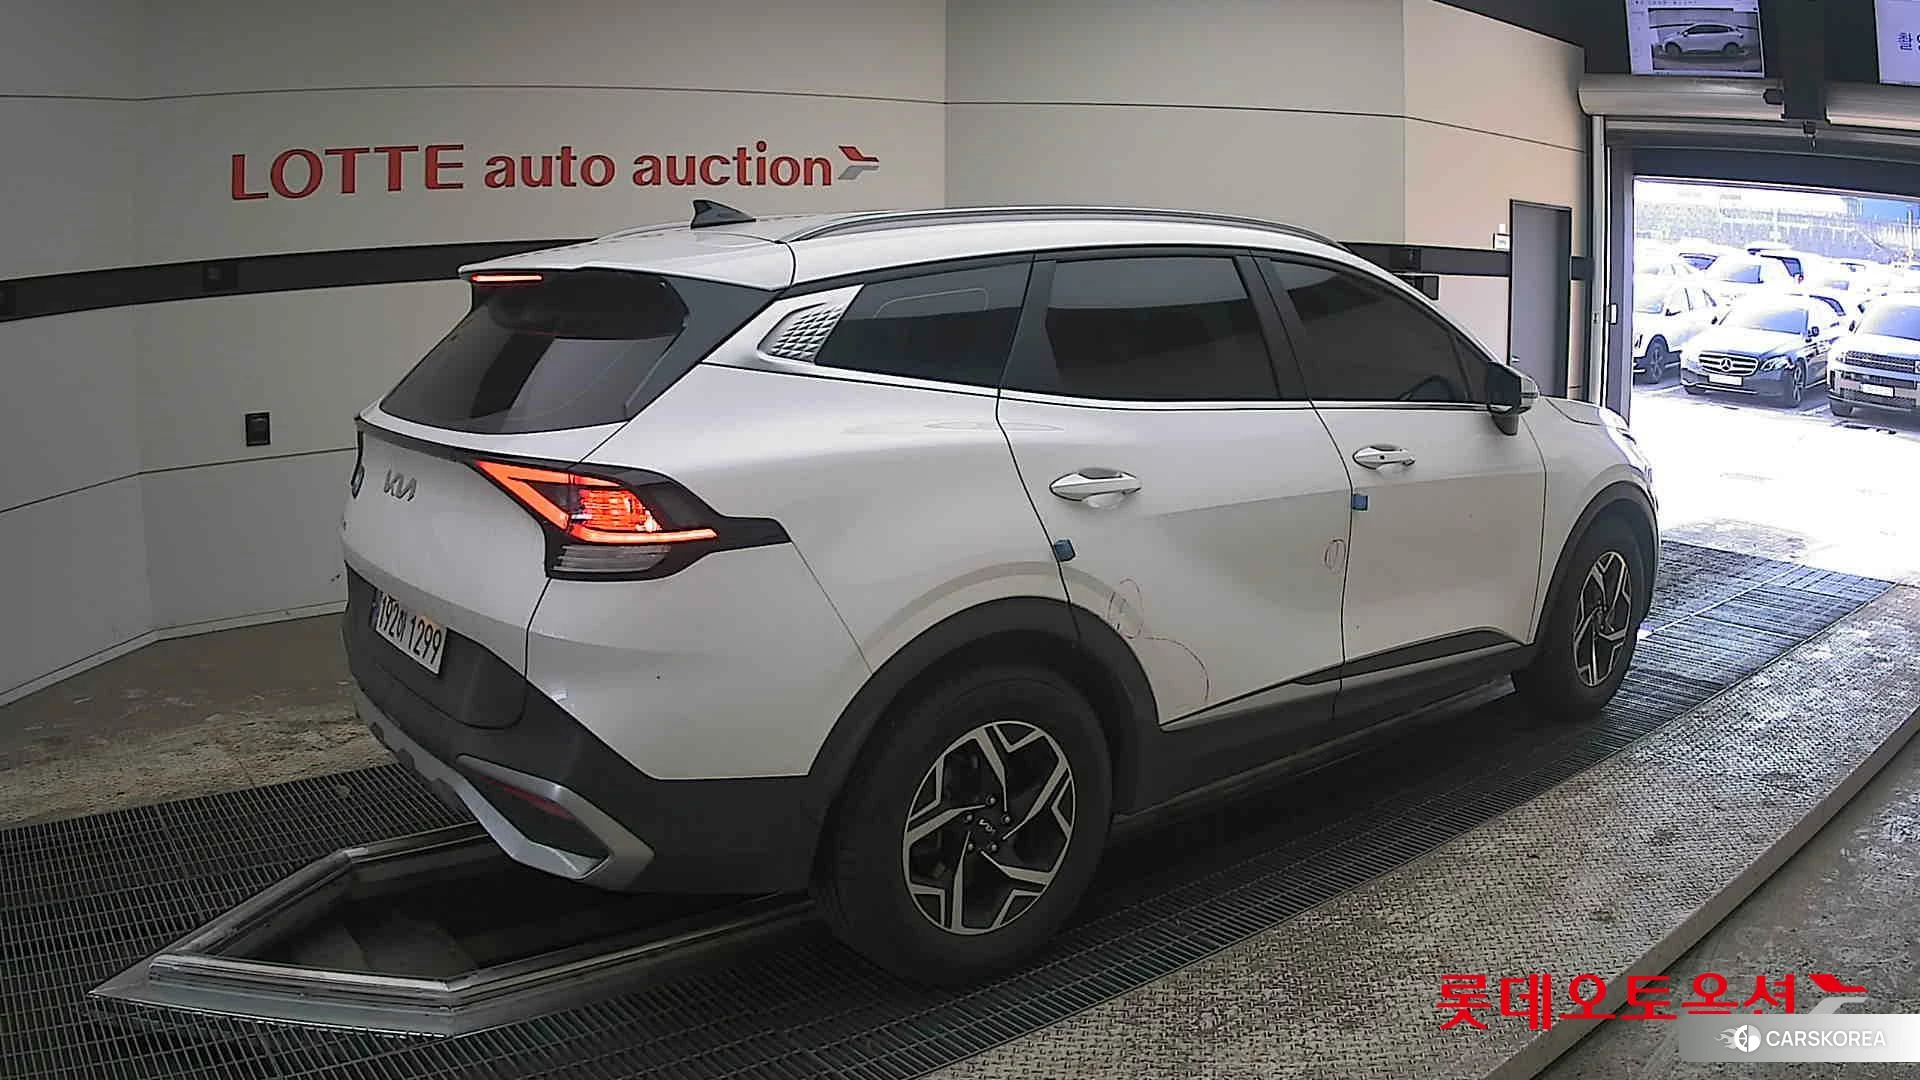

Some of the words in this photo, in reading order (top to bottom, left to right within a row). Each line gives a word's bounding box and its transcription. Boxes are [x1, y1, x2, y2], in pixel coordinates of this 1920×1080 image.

[231, 144, 464, 200] LOTTE
[484, 146, 616, 188] auto
[632, 141, 832, 187] auction
[408, 615, 442, 665] 1299
